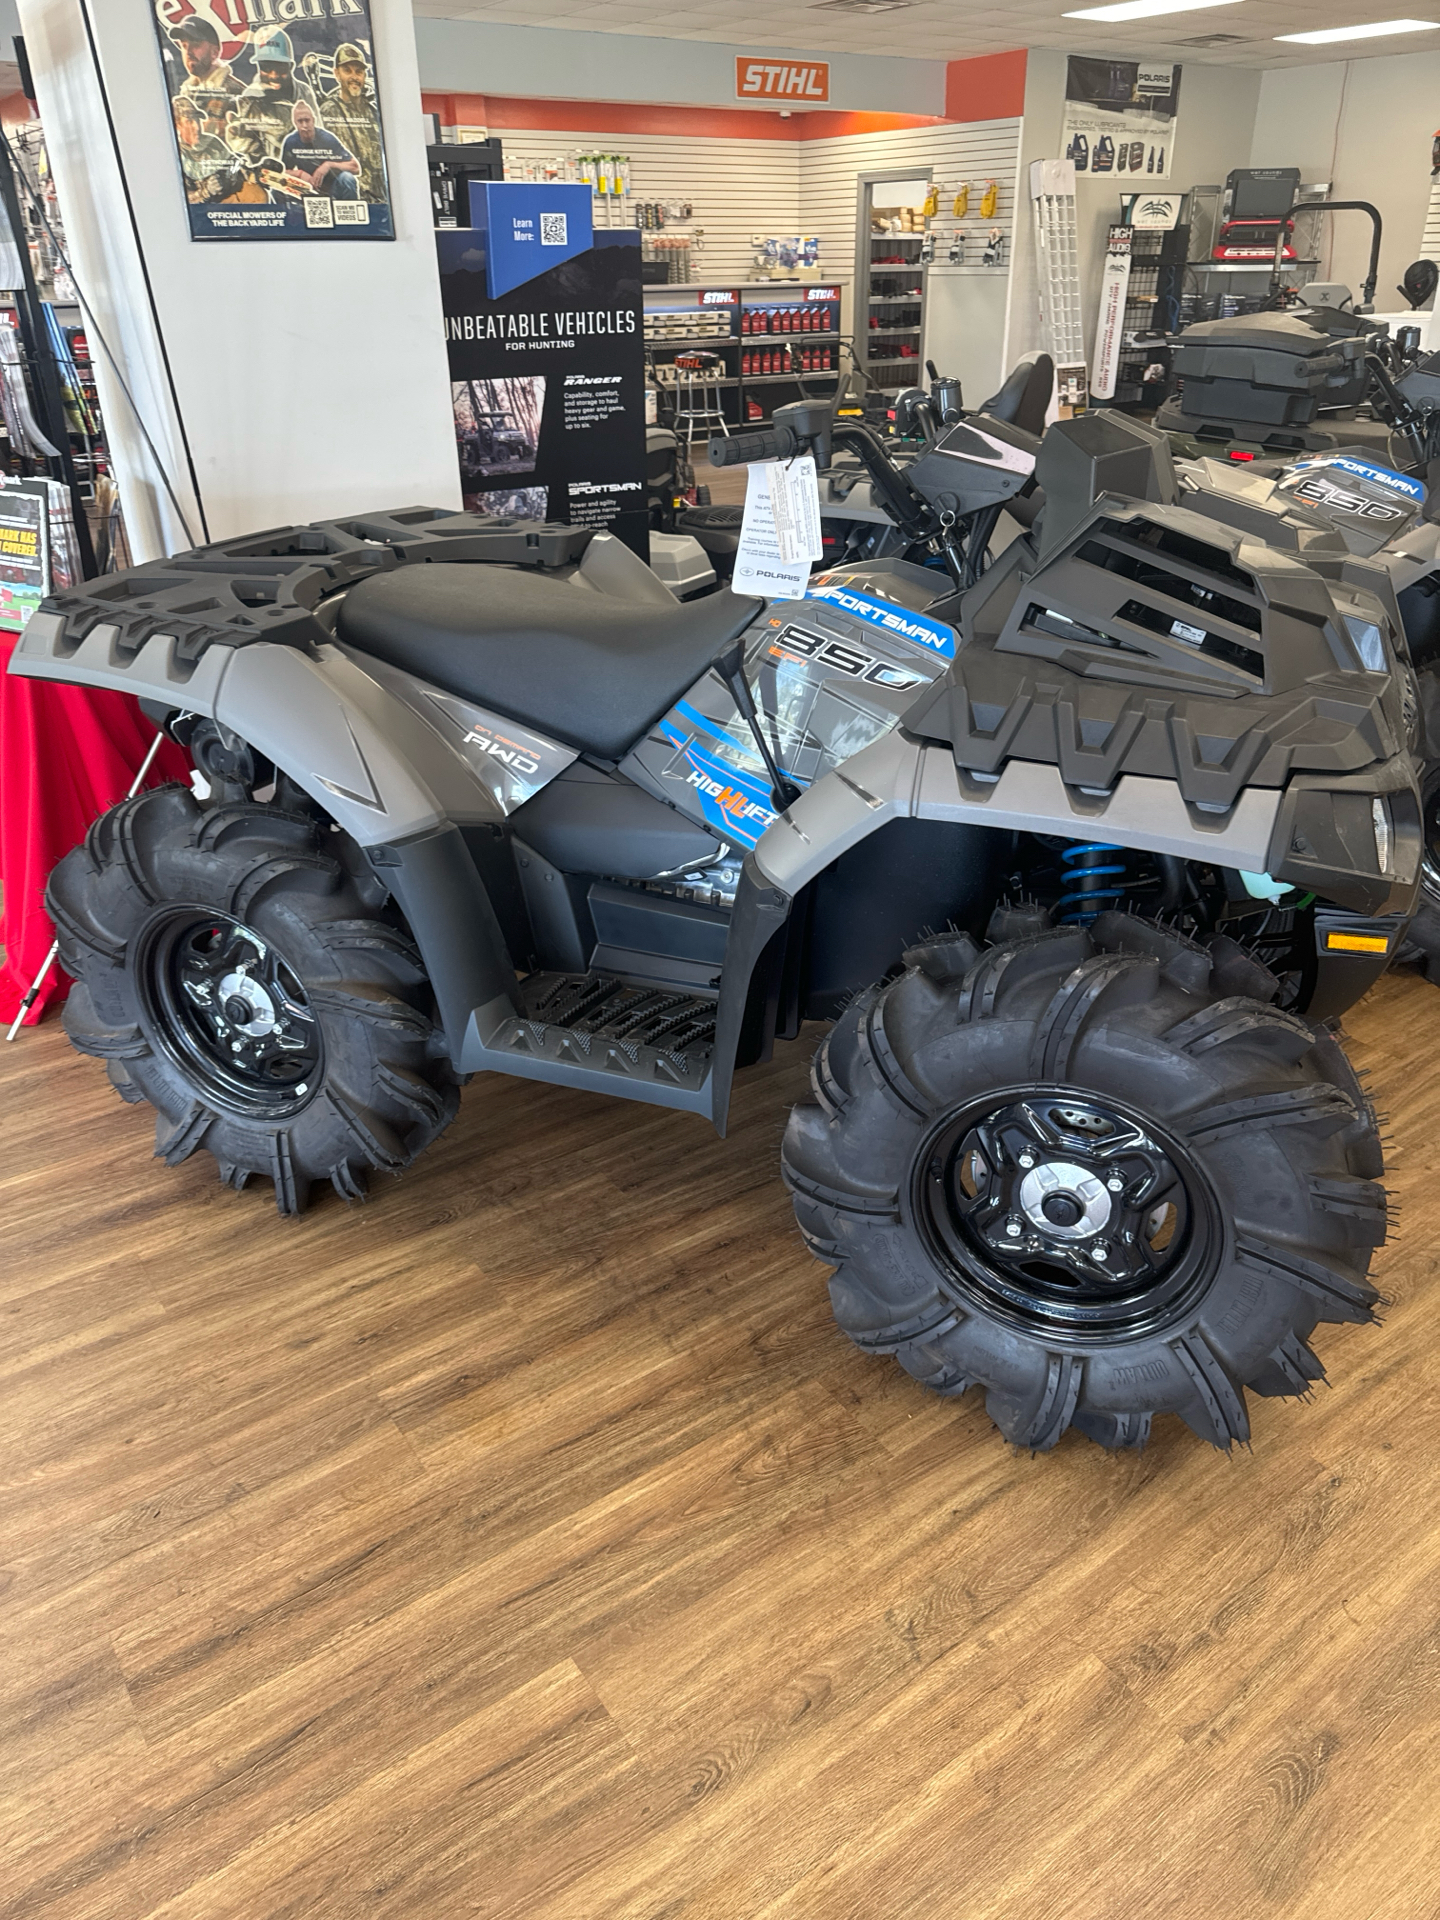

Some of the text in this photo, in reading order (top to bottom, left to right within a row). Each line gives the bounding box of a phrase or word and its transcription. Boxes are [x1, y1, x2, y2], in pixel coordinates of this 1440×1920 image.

[742, 64, 824, 96] STIHL
[1138, 74, 1171, 83] POLARIS
[513, 218, 533, 228] Learn
[514, 231, 534, 241] More:
[1110, 228, 1133, 239] HIGH
[703, 292, 734, 304] STIHL
[444, 313, 549, 340] UNBEATABLE
[555, 310, 635, 335] VEHICLES
[1105, 305, 1117, 366] PERFORMANCE
[506, 340, 575, 351] FOR HUNTING
[674, 358, 703, 368] STIHL
[564, 376, 622, 386] RANGER
[564, 391, 594, 399] Capability,
[568, 482, 642, 495] SPORTSMAN
[1294, 480, 1402, 521] 850
[756, 570, 800, 582] POLARIS
[768, 646, 808, 667] EFI
[774, 623, 922, 691] 850
[462, 731, 539, 774] AWD
[1113, 1359, 1170, 1384] OUTLAW
